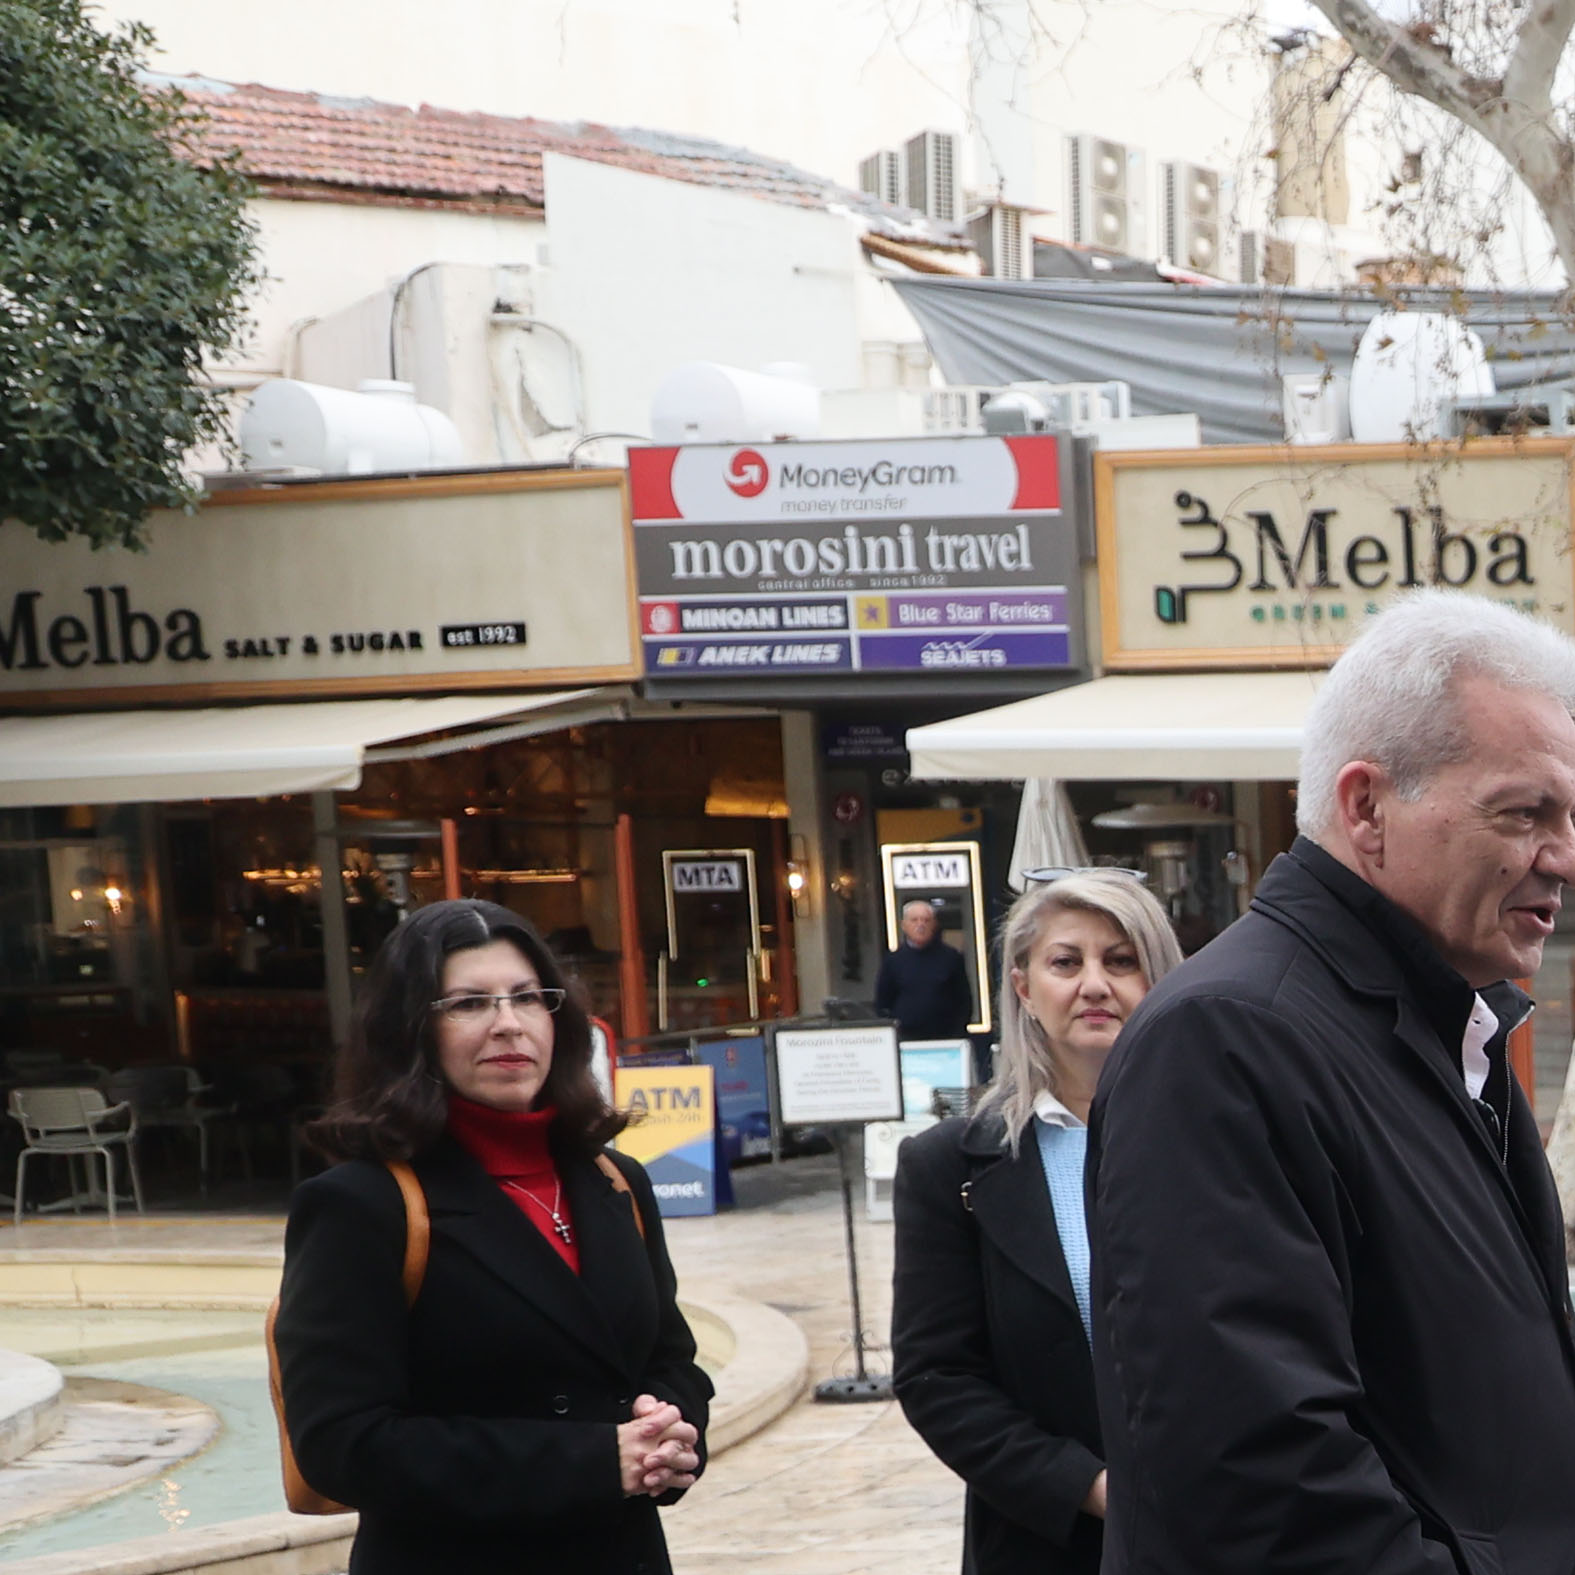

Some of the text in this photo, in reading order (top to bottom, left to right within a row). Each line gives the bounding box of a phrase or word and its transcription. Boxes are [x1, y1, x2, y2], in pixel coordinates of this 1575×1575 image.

[781, 496, 908, 514] money transfer
[669, 522, 1035, 581] morosini travel
[1246, 505, 1536, 594] Melba
[911, 574, 946, 587] 1992
[682, 604, 846, 631] MINOAN LINES
[898, 602, 1053, 624] Blue Star Ferries
[224, 636, 292, 659] SALT
[304, 635, 319, 655] &
[330, 631, 424, 654] SUGAR
[446, 628, 473, 647] est
[478, 625, 518, 644] 1992
[698, 643, 843, 666] ANEK LINES
[920, 649, 1006, 667] SEAJETS
[899, 861, 960, 880] ATM
[629, 1086, 702, 1111] ATM
